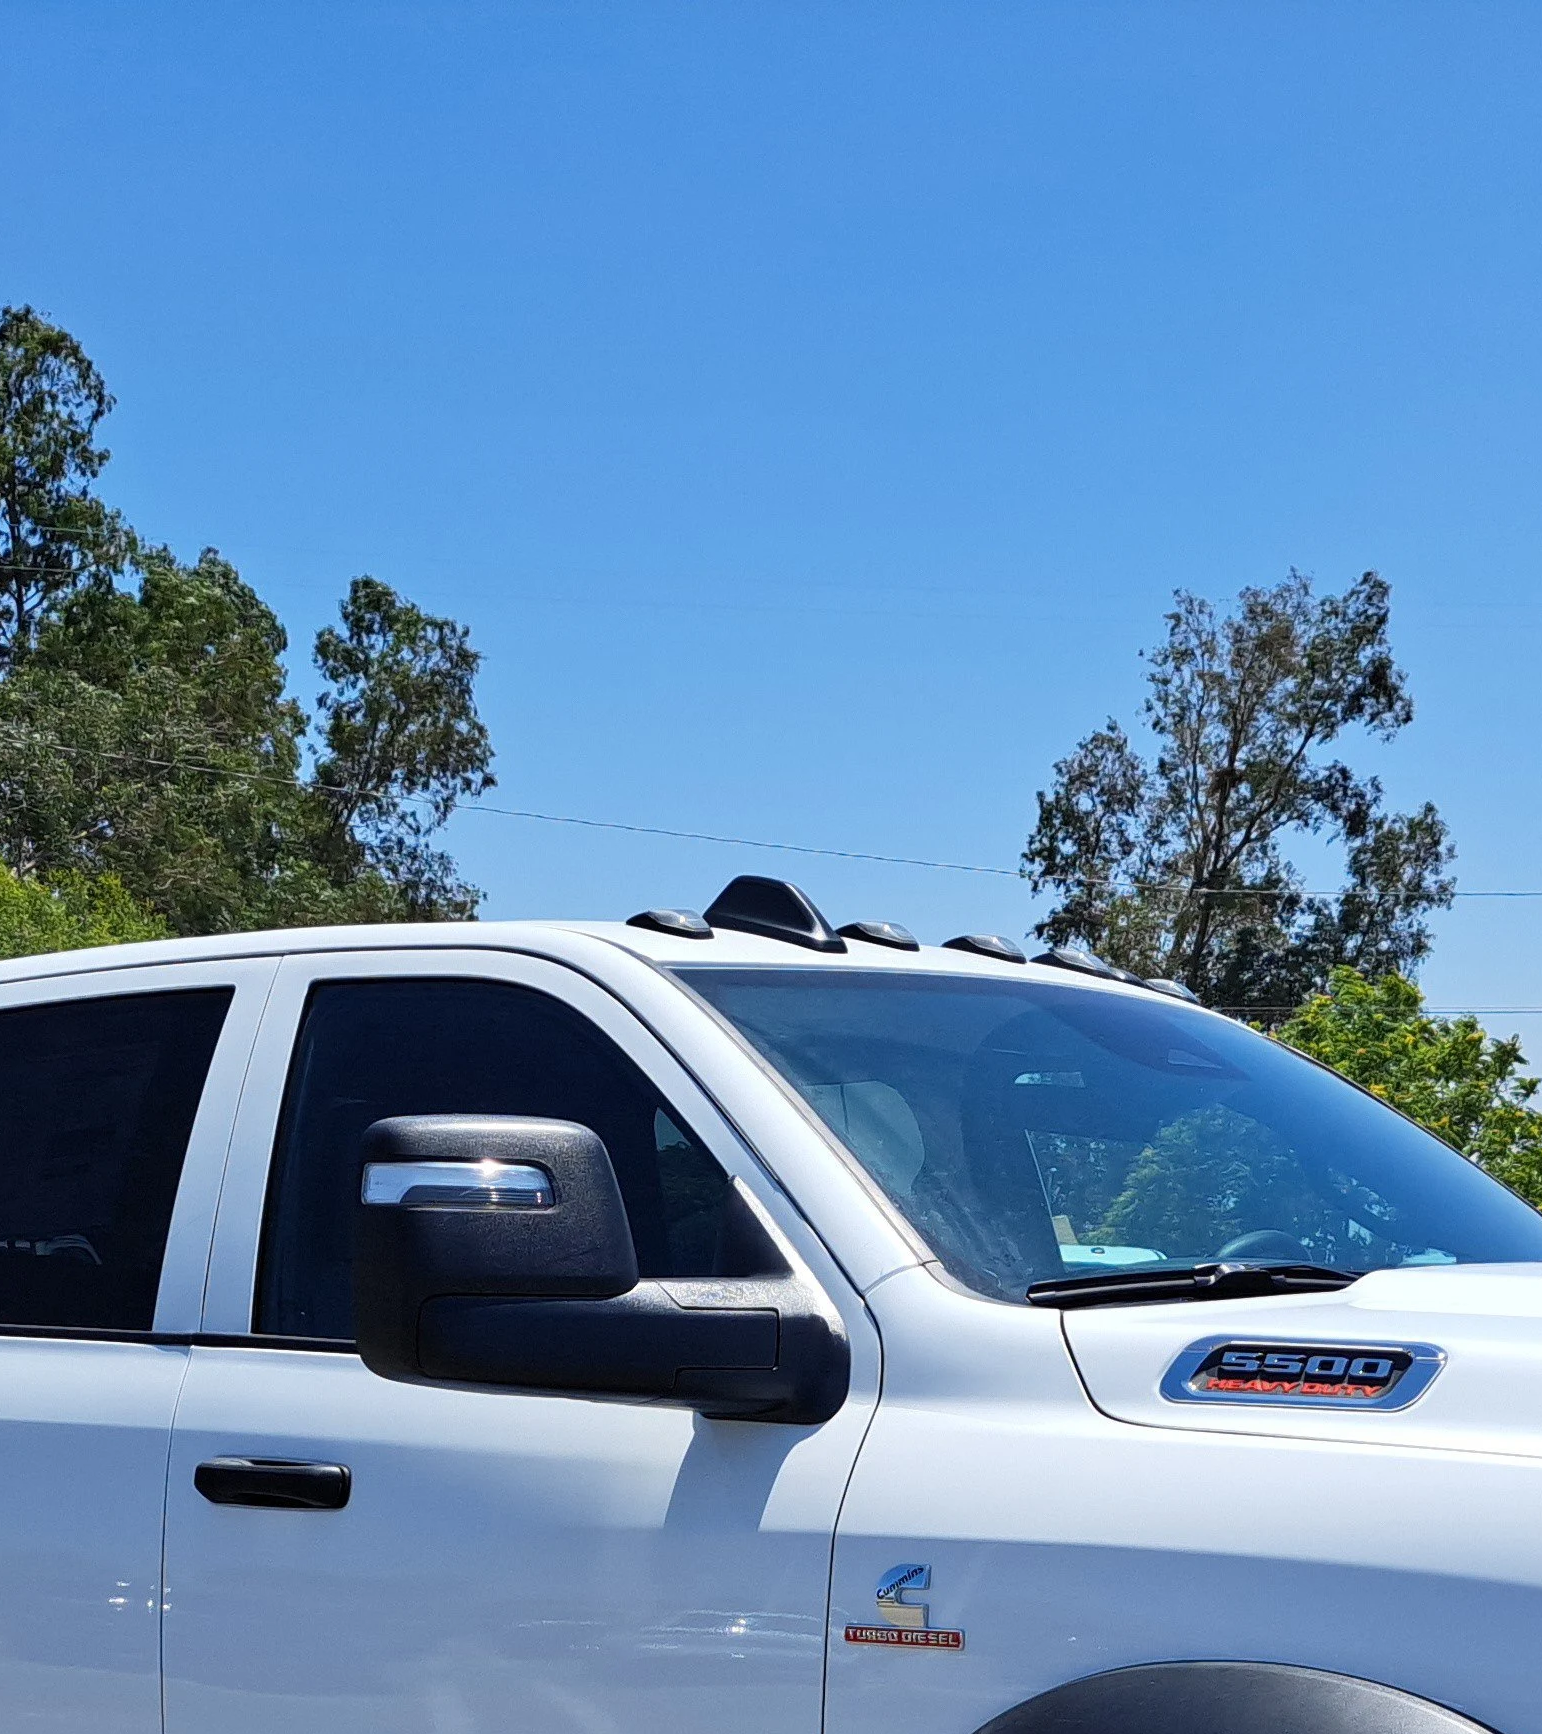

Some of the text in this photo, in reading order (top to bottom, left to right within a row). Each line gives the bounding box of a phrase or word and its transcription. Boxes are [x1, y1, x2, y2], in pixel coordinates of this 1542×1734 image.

[1220, 1351, 1394, 1378] 5500
[1206, 1378, 1383, 1398] HEAVY DUTY
[876, 1567, 925, 1600] Cummins
[847, 1628, 959, 1645] TURBO DIESEL
